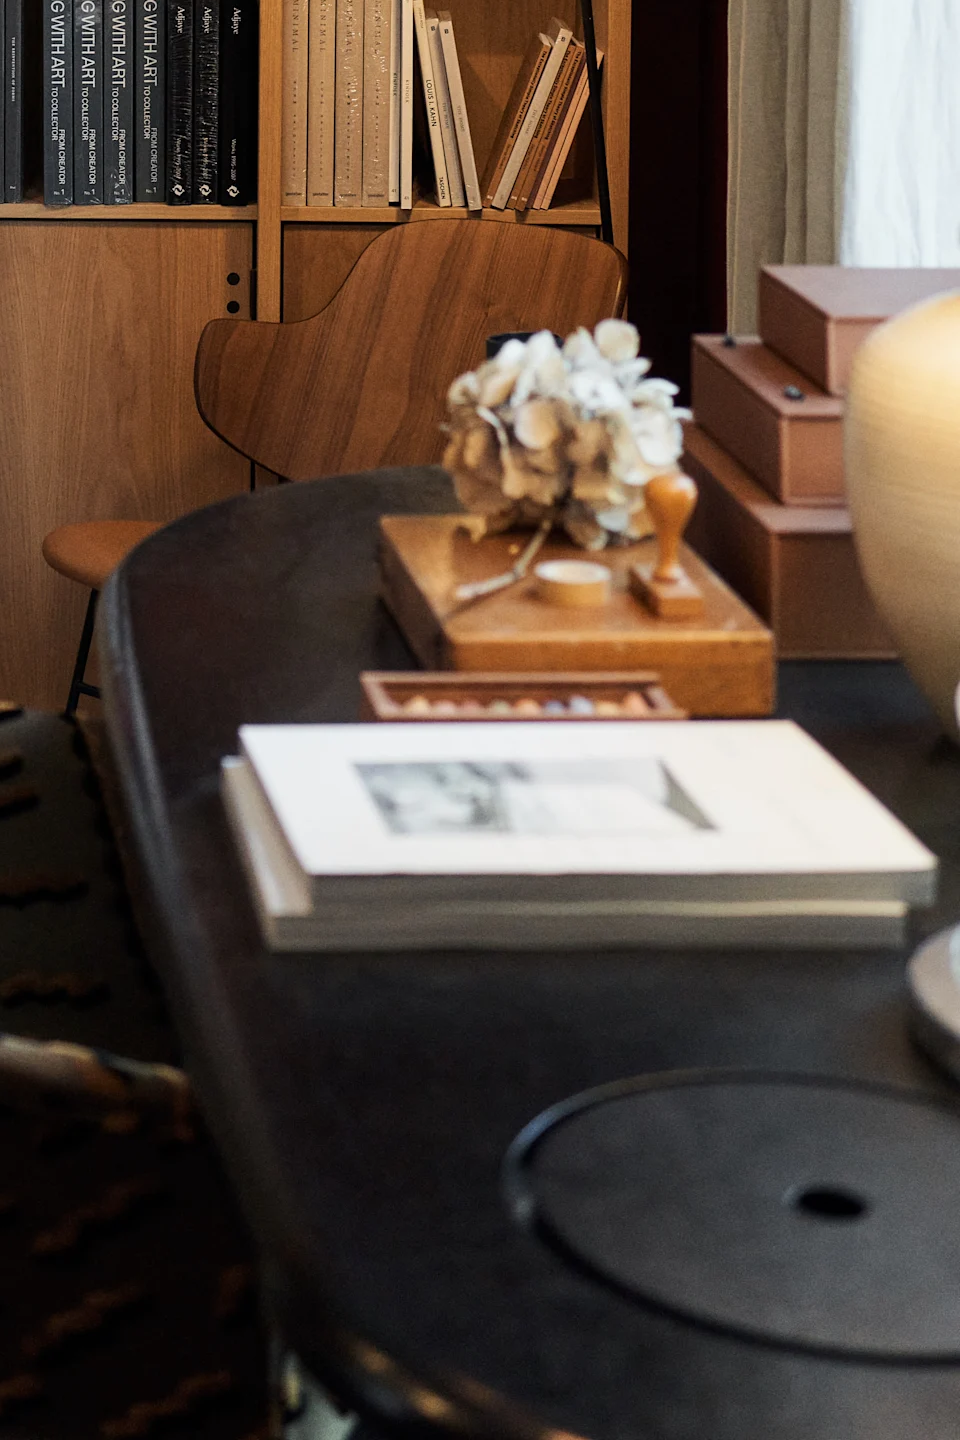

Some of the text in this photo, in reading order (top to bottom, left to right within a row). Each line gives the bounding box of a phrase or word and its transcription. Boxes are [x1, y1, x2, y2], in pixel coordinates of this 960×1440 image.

[143, 14, 158, 53] WITH
[176, 6, 186, 34] Adjaye
[202, 6, 212, 34] Adjaye
[231, 8, 241, 34] Adjaye
[50, 16, 65, 54] WITH
[81, 16, 96, 54] WITH
[112, 16, 126, 54] WITH
[50, 57, 65, 88] ART
[81, 57, 96, 88] ART
[112, 57, 126, 88] ART
[143, 56, 158, 86] ART
[51, 87, 58, 96] TO
[82, 87, 88, 96] TO
[112, 87, 119, 96] TO
[144, 85, 150, 94] TO
[426, 79, 434, 100] LOUIS
[429, 108, 438, 127] KAHN
[438, 176, 446, 200] TASCHEN
